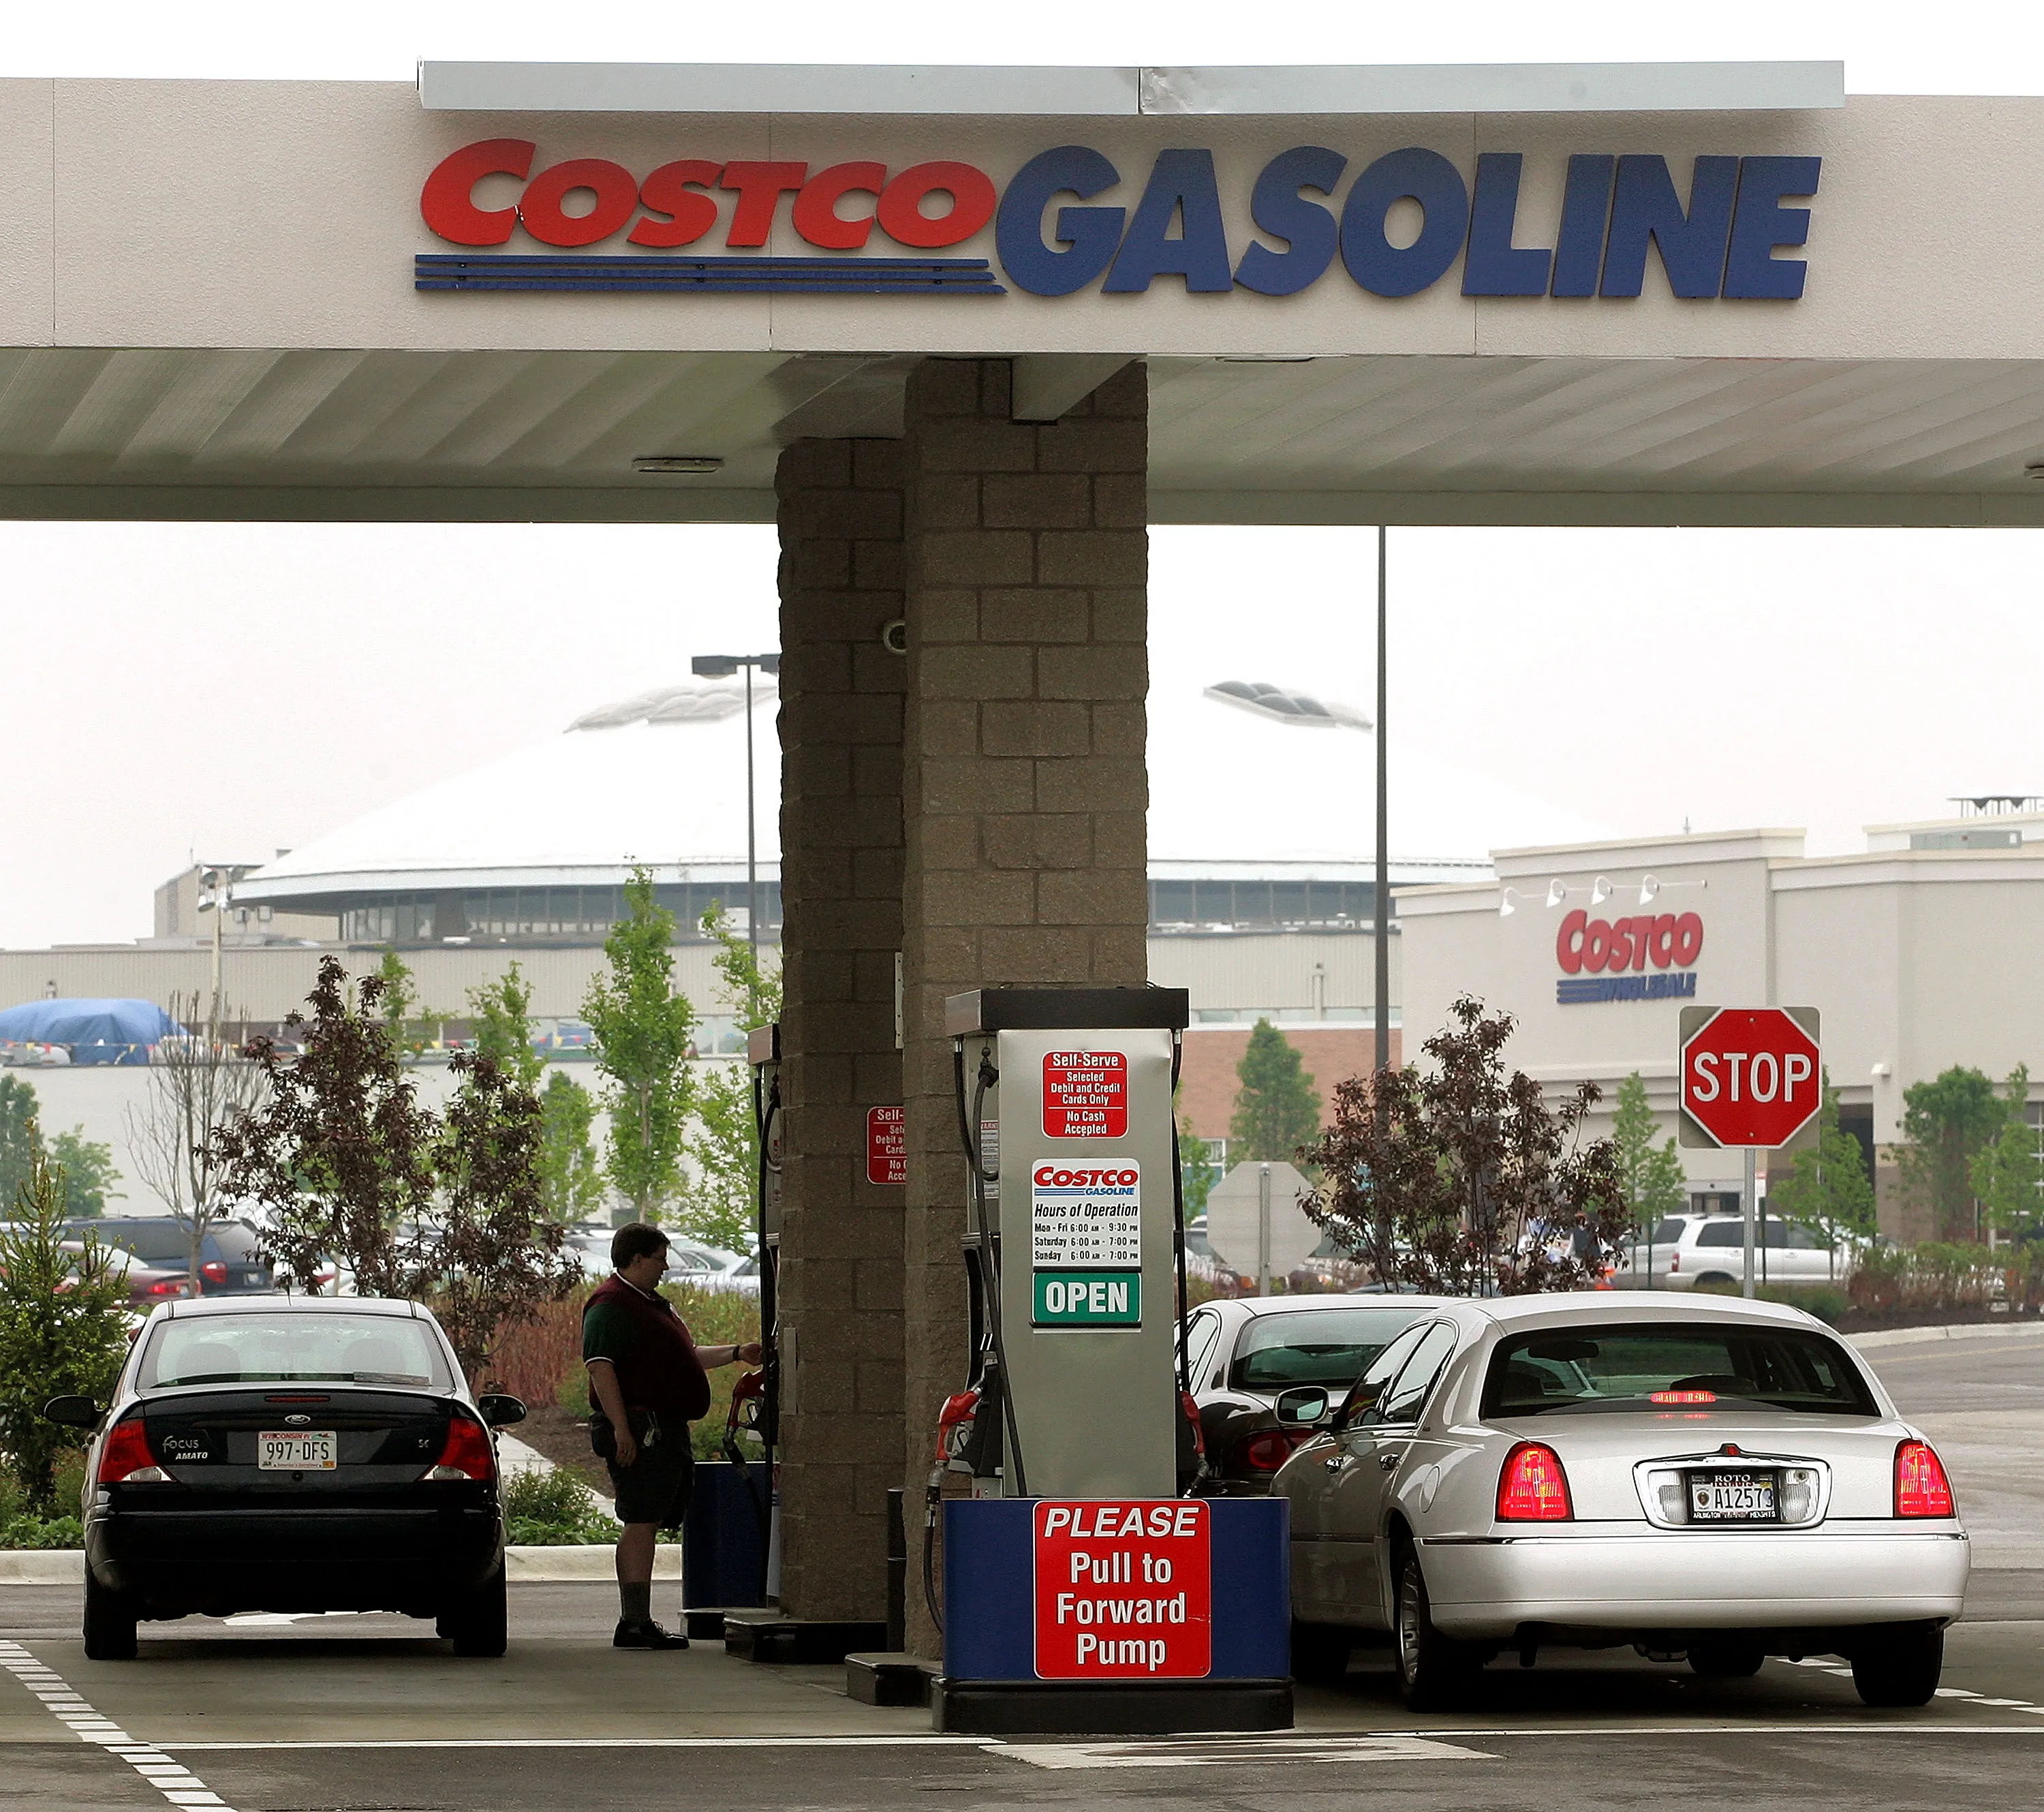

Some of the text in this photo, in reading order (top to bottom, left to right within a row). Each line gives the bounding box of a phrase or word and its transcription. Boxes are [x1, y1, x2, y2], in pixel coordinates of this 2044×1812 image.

[420, 138, 1823, 299] COSTCO GASOLINE
[1557, 908, 1703, 973] COSTCO
[1053, 1053, 1119, 1066] Self-Serve
[1066, 1071, 1104, 1082] Selected
[1692, 1051, 1812, 1103] STOP
[1051, 1083, 1120, 1093] Debit and Credit
[1062, 1094, 1109, 1107] Cards Only
[1067, 1111, 1105, 1121] No Cash
[1064, 1124, 1107, 1135] Accepted
[876, 1135, 896, 1144] Debit
[890, 1160, 901, 1169] No
[1034, 1166, 1139, 1186] COSTCO
[1034, 1203, 1139, 1219] Hours of Operation
[1034, 1223, 1051, 1232] Mon
[1057, 1223, 1068, 1232] Fri
[1070, 1223, 1089, 1232] 6:00
[1109, 1223, 1127, 1231] 9:30
[1034, 1237, 1067, 1248] Saturday
[1070, 1238, 1089, 1246] 6:00
[1109, 1237, 1127, 1246] 7:00
[1034, 1250, 1062, 1261] Sunday
[1070, 1250, 1090, 1260] 6:00
[1109, 1250, 1127, 1259] 7:00
[1046, 1281, 1128, 1313] OPEN
[175, 1452, 208, 1460] AMATO
[266, 1442, 329, 1460] 997-DFS
[1714, 1474, 1750, 1482] ROTO
[1044, 1507, 1199, 1537] PLEASE
[1070, 1552, 1172, 1583] Pull to
[1057, 1592, 1186, 1625] Forward
[1077, 1633, 1166, 1672] Pump
